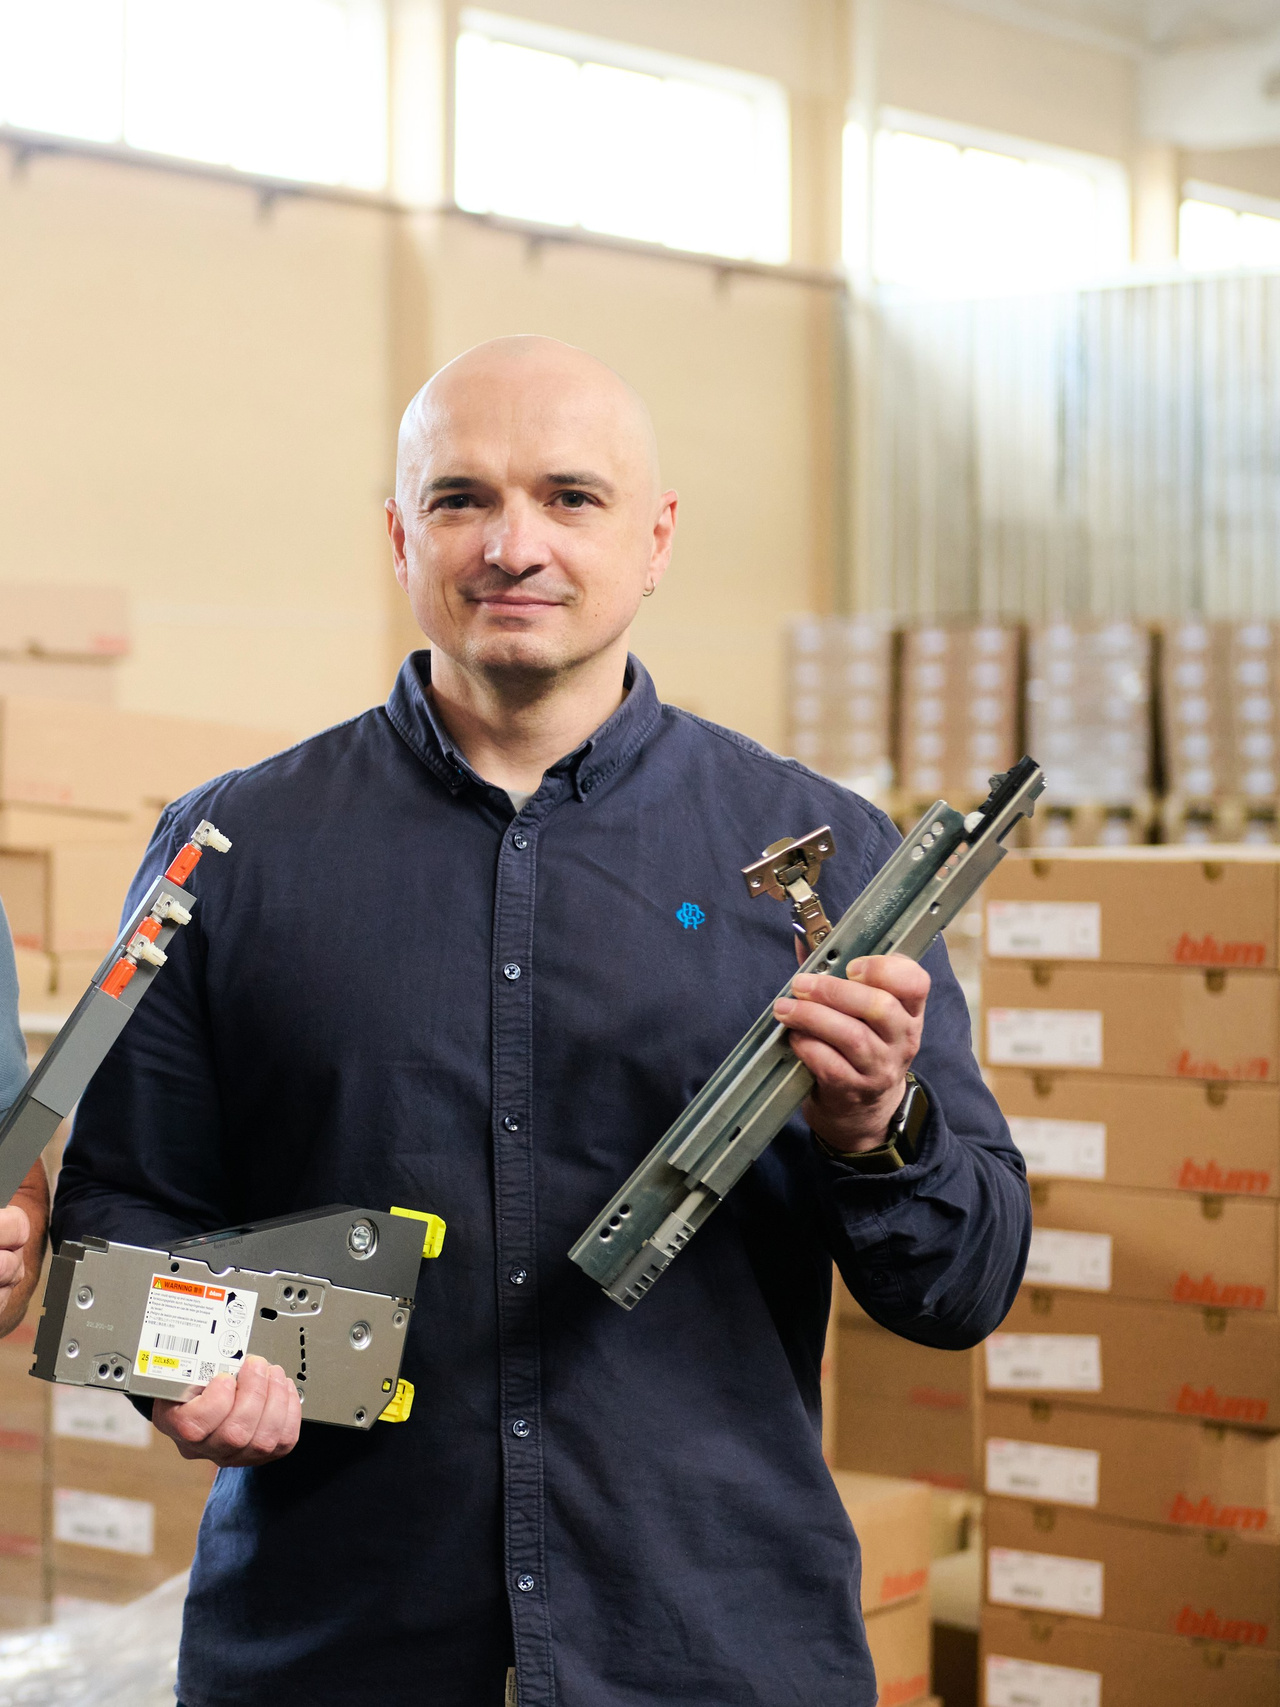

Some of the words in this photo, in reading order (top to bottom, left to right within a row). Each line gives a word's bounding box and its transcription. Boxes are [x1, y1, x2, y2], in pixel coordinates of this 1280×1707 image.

[1175, 932, 1266, 966] blum
[1176, 1158, 1271, 1195] blum
[164, 1281, 192, 1292] WARNING
[1173, 1272, 1266, 1309] blum
[1176, 1383, 1269, 1422] blum
[1169, 1493, 1268, 1531] blum
[1175, 1605, 1269, 1645] blum
